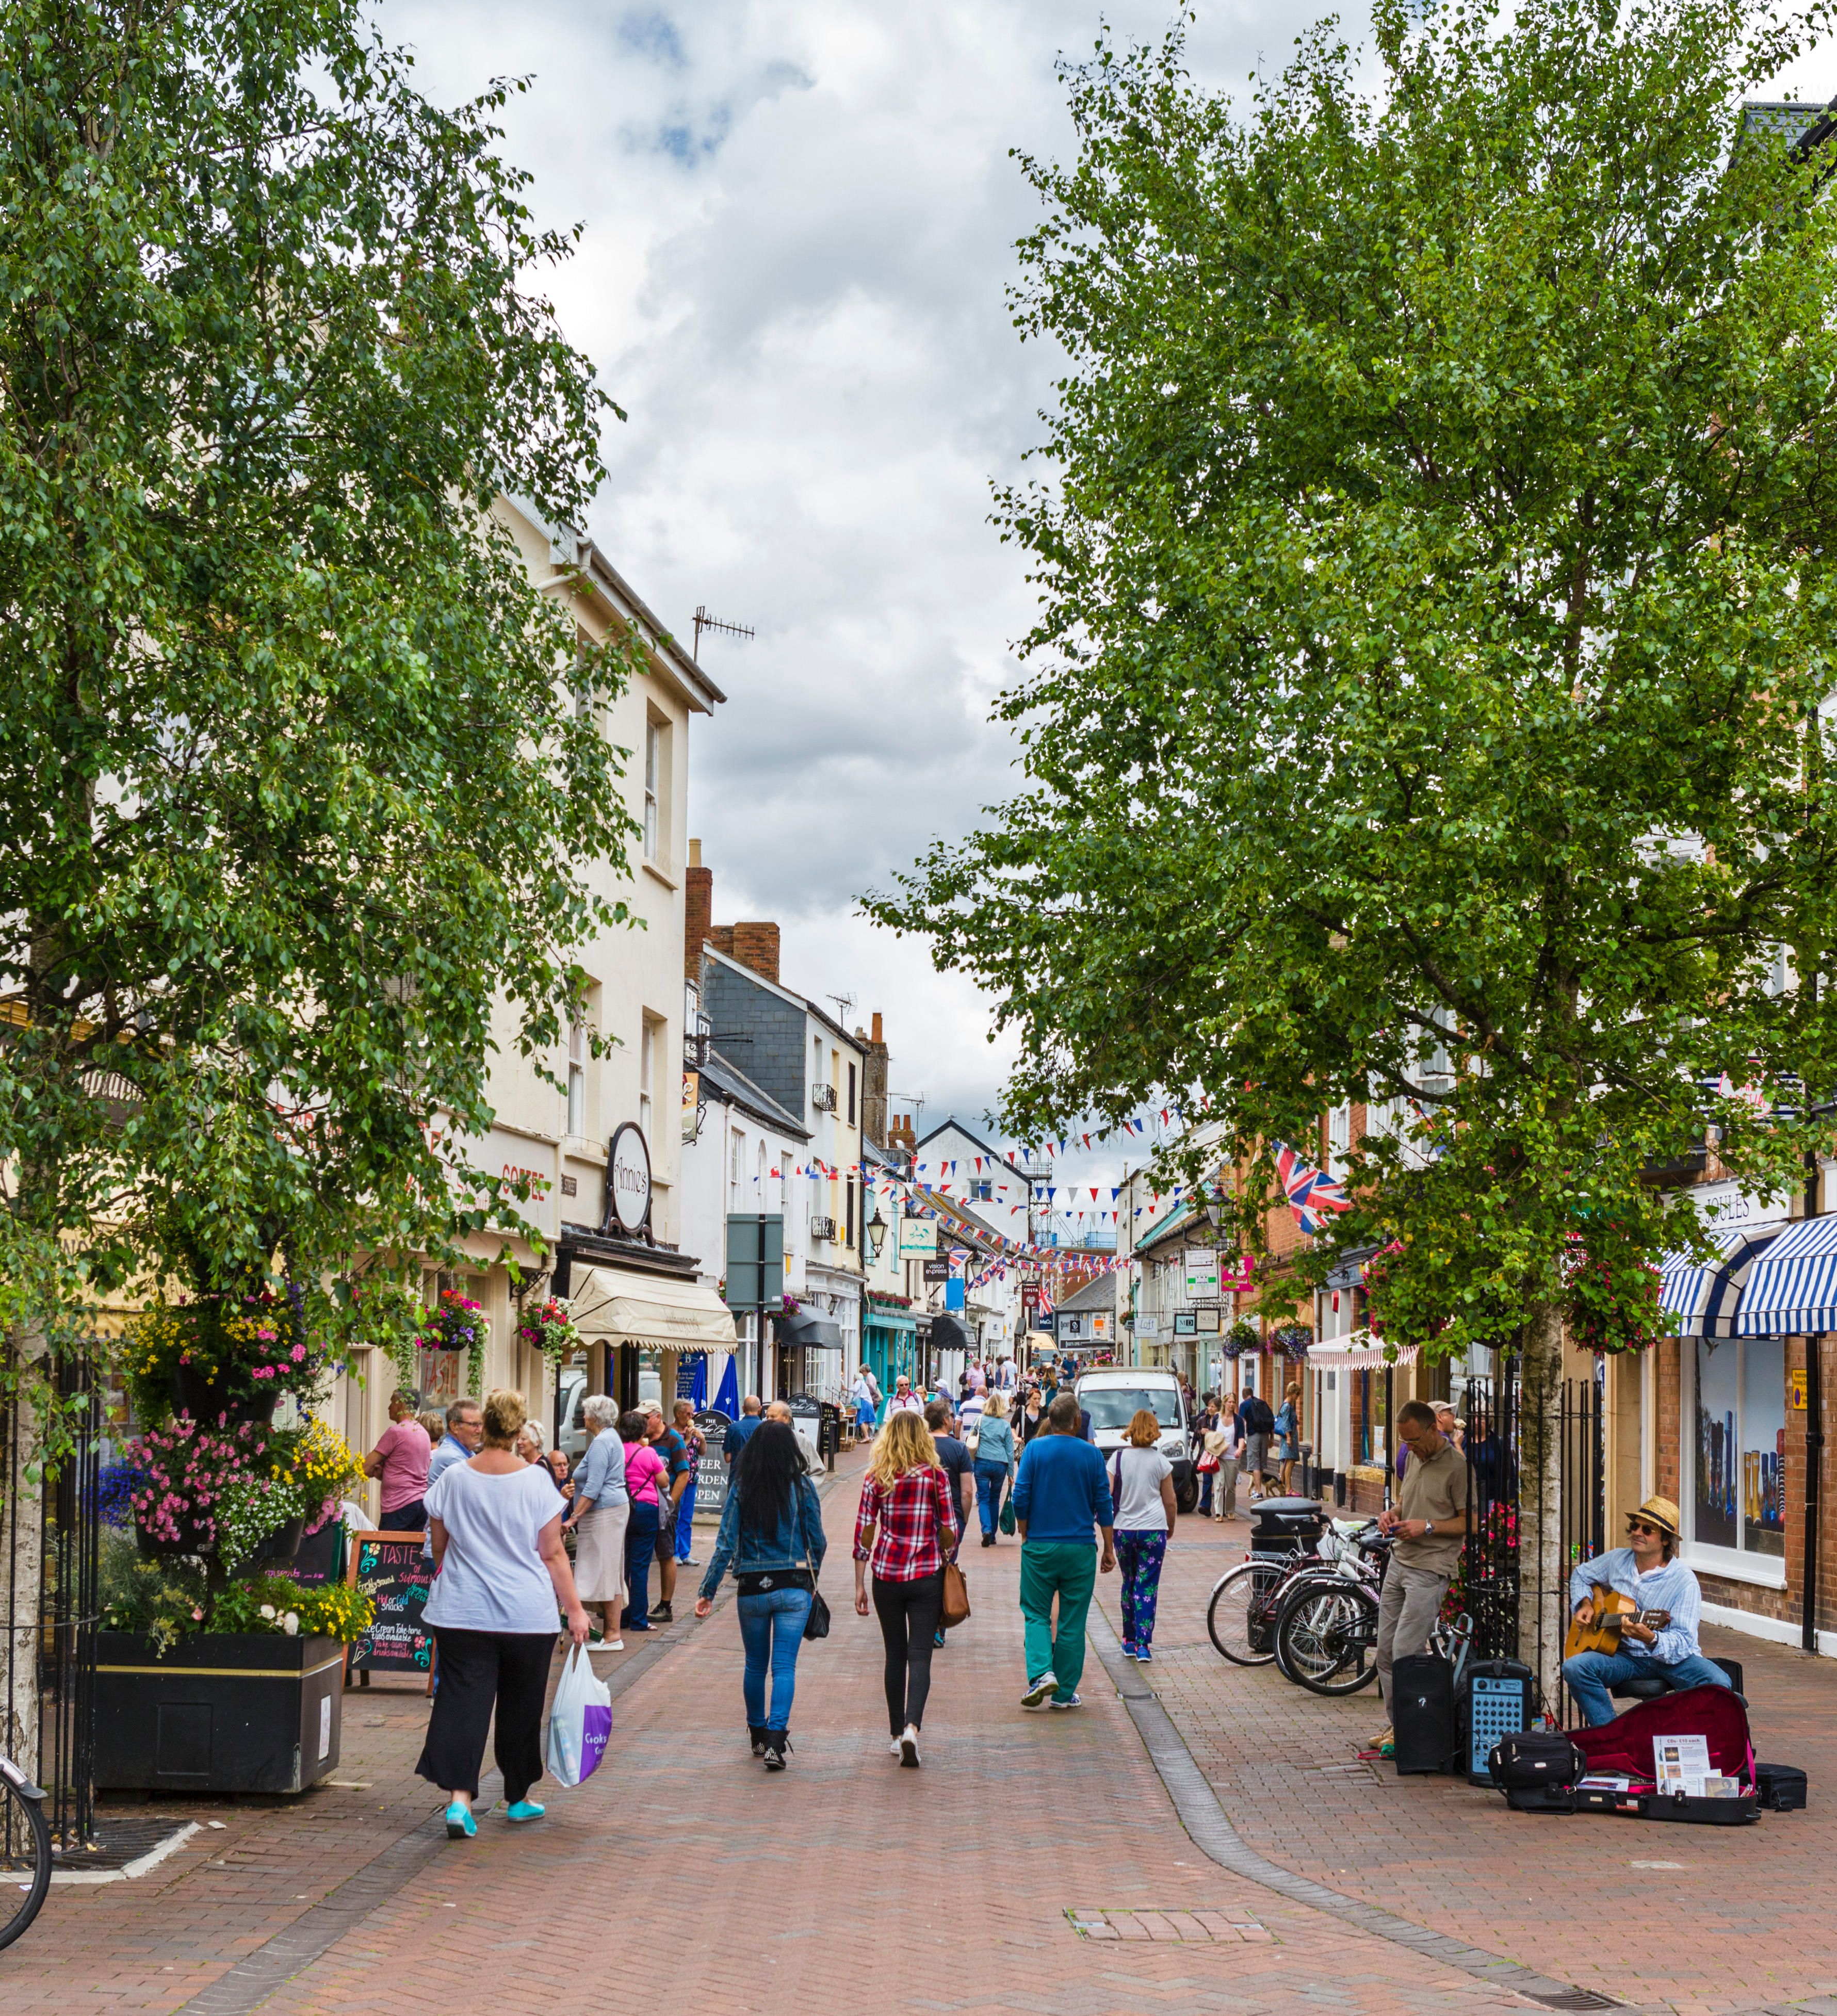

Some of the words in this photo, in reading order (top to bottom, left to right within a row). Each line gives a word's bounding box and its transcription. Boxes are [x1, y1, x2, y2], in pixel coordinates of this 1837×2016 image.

[502, 1164, 545, 1201] COFEE
[615, 1157, 646, 1197] Annies
[564, 1178, 576, 1193] STREET
[1705, 1193, 1749, 1224] JOULES
[1140, 1319, 1155, 1330] Loft
[424, 1353, 459, 1395] TASTE
[697, 1459, 722, 1470] EER
[697, 1475, 728, 1485] RDEN
[382, 1544, 419, 1565] TASTE
[413, 1565, 421, 1573] of
[377, 1594, 388, 1604] Hot
[396, 1594, 409, 1605] Cold
[381, 1603, 404, 1612] snacks
[385, 1633, 412, 1643] available
[372, 1649, 390, 1657] drinks
[389, 1650, 413, 1659] available
